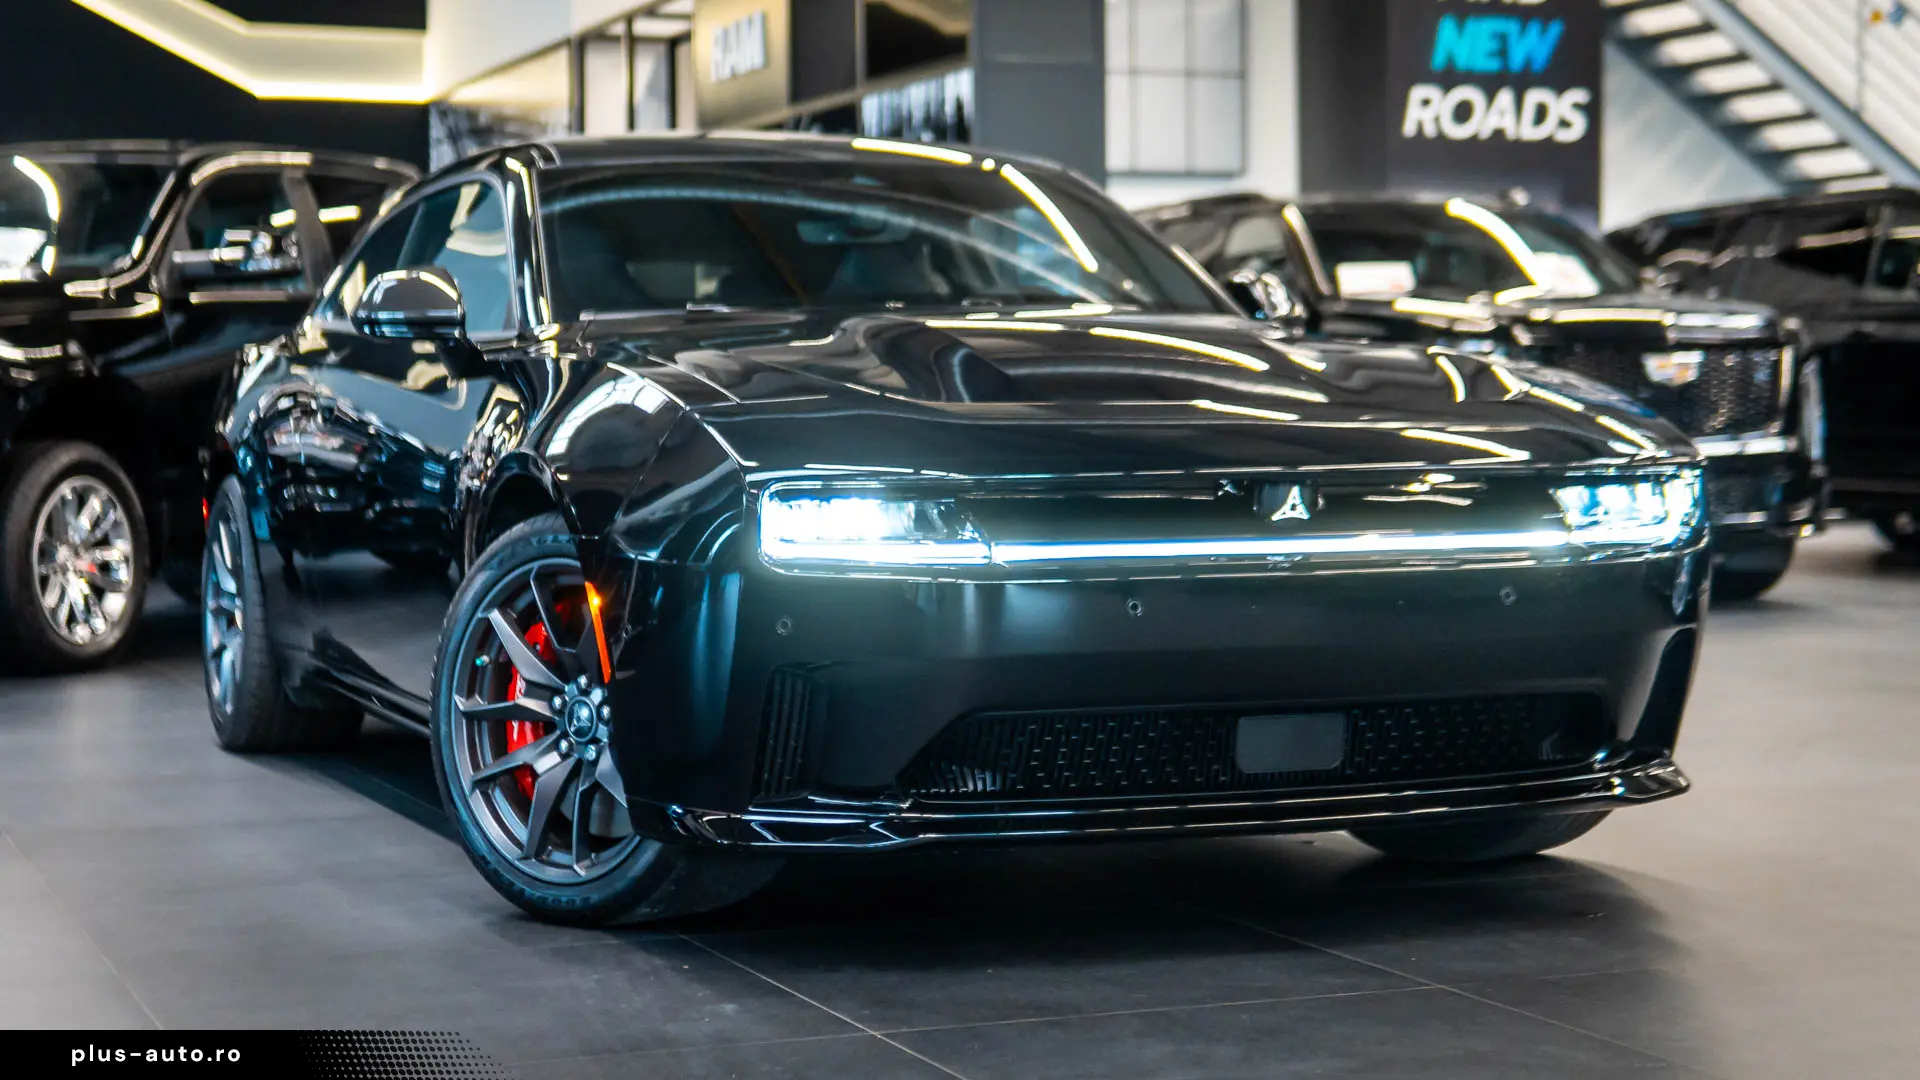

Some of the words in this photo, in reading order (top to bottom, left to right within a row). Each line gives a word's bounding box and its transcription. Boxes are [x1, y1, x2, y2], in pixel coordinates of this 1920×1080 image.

[711, 9, 764, 82] RAM
[1431, 15, 1564, 72] NEW
[1402, 84, 1590, 142] ROADS
